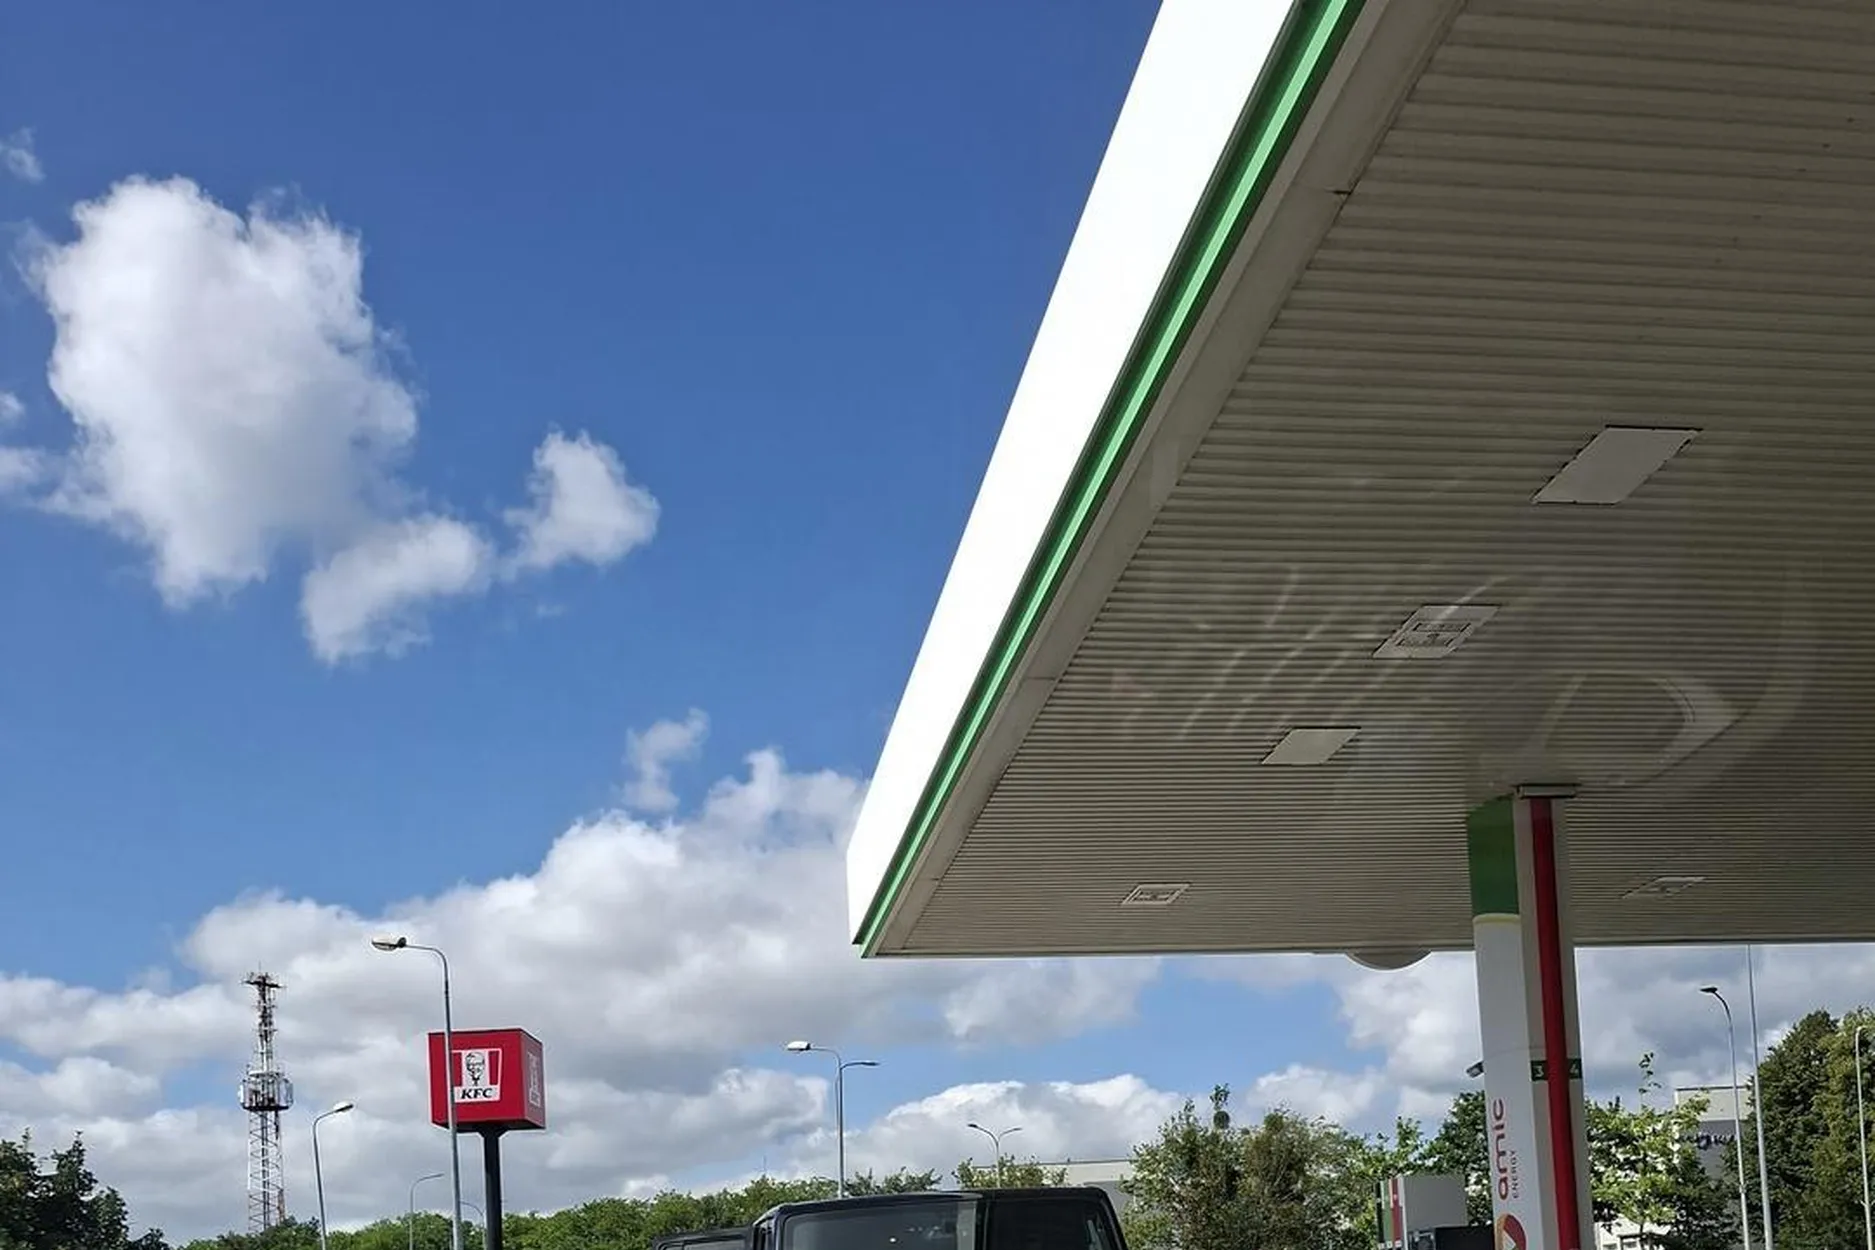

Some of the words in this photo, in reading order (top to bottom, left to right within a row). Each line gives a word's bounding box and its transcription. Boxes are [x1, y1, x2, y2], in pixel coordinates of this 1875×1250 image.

[1535, 1064, 1545, 1078] 3
[461, 1088, 493, 1099] KFC
[1493, 1098, 1509, 1201] amic
[1509, 1150, 1519, 1199] ENERGY
